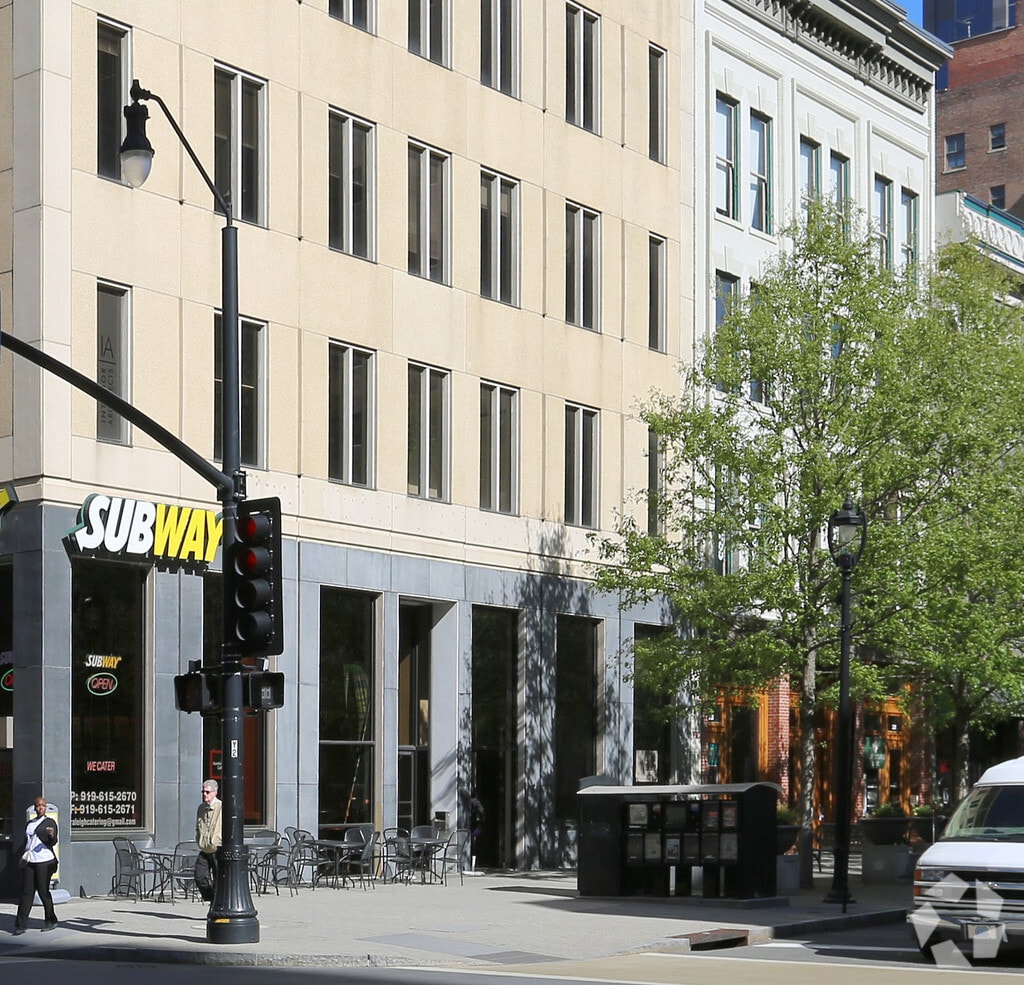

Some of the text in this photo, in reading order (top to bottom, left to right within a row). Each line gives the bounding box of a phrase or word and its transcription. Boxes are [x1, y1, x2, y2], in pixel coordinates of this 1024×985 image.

[100, 334, 114, 359] IA
[75, 494, 223, 563] SUBWAY
[85, 654, 122, 669] SUBWAY
[90, 677, 114, 690] OPEN
[86, 761, 115, 771] WE CATER
[70, 791, 79, 801] P:
